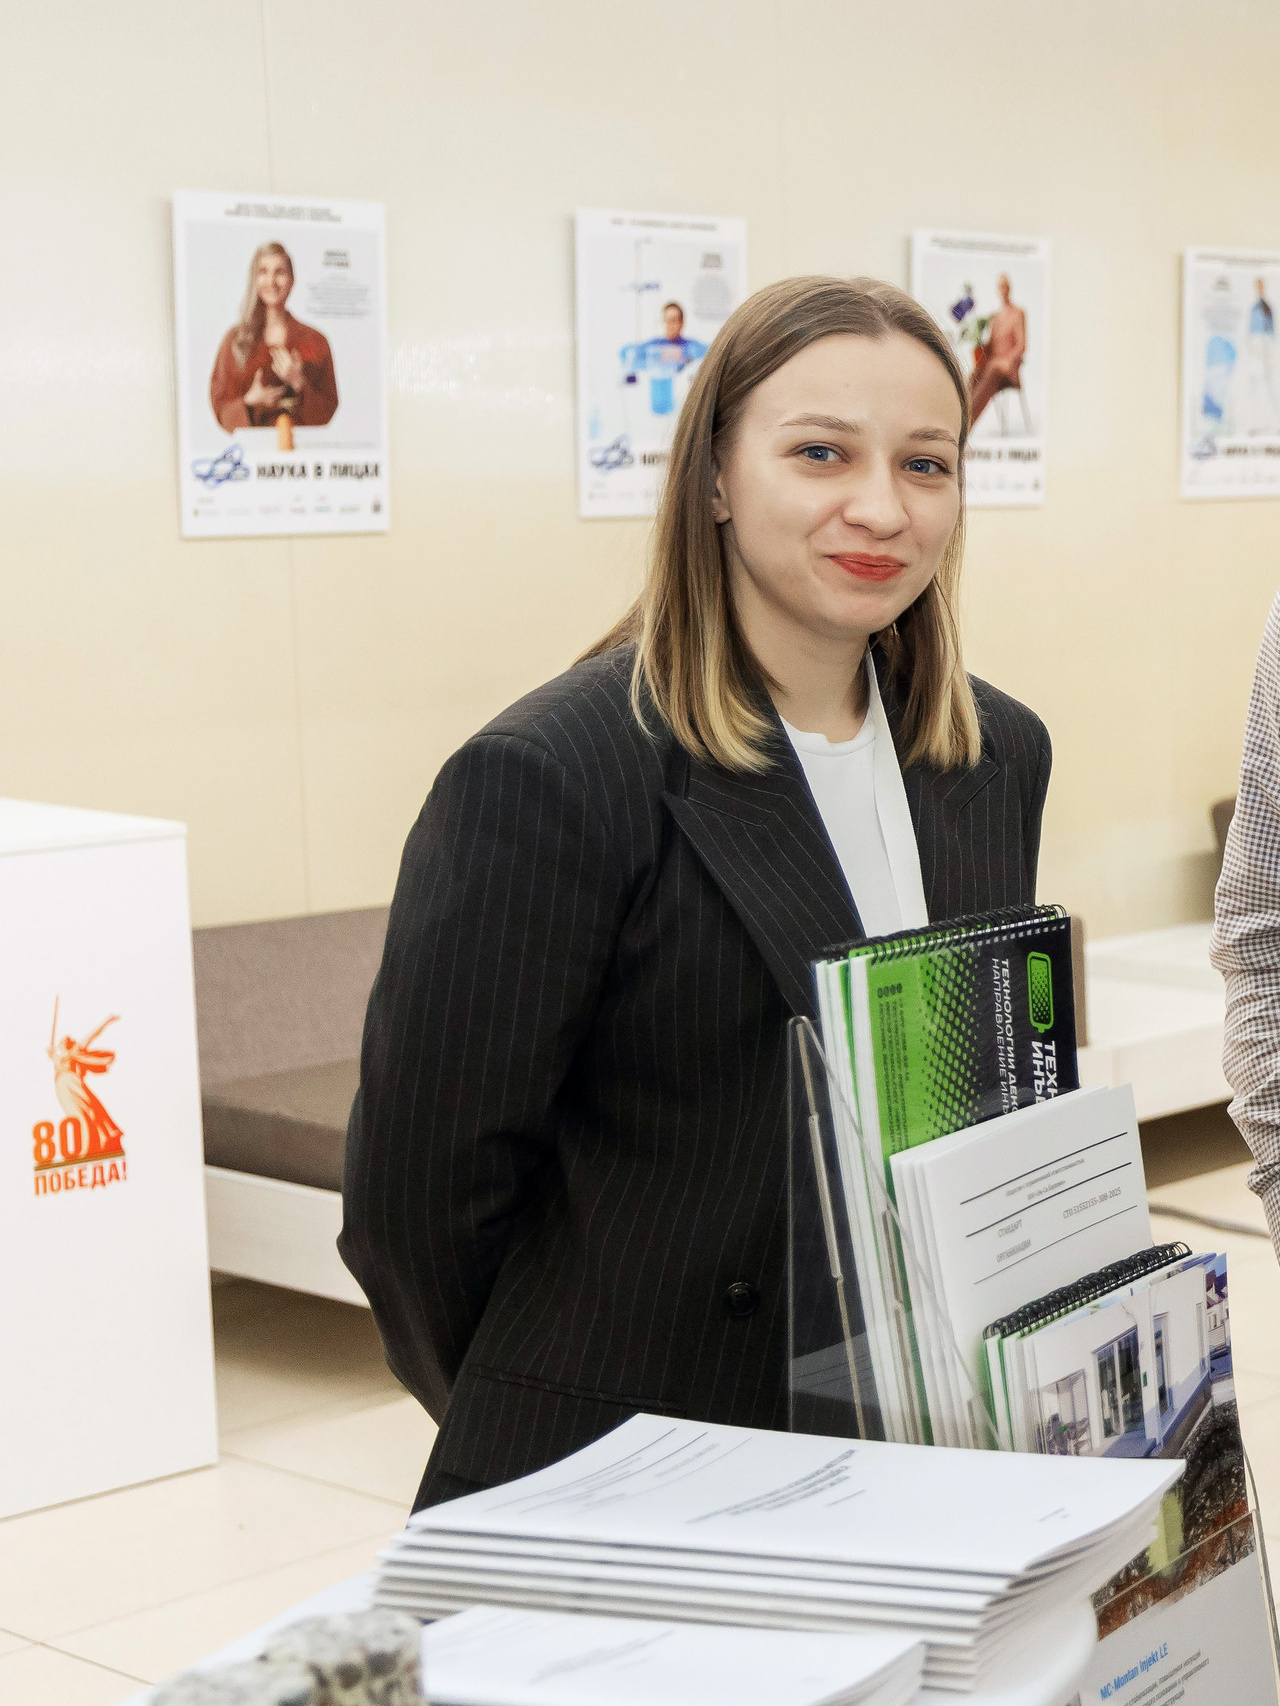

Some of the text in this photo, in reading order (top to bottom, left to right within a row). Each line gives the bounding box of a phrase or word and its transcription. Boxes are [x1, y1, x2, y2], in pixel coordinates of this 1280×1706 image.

[992, 958, 1007, 1078] НАПРАВЛЕНИЕ
[1001, 958, 1016, 1069] ТЕХНОЛОГИИ
[32, 1116, 82, 1164] 80
[34, 1160, 128, 1196] ПОБЕДА!
[1100, 1666, 1139, 1701] MC-Montan
[1139, 1650, 1159, 1673] Injekt
[1159, 1642, 1169, 1659] LE
